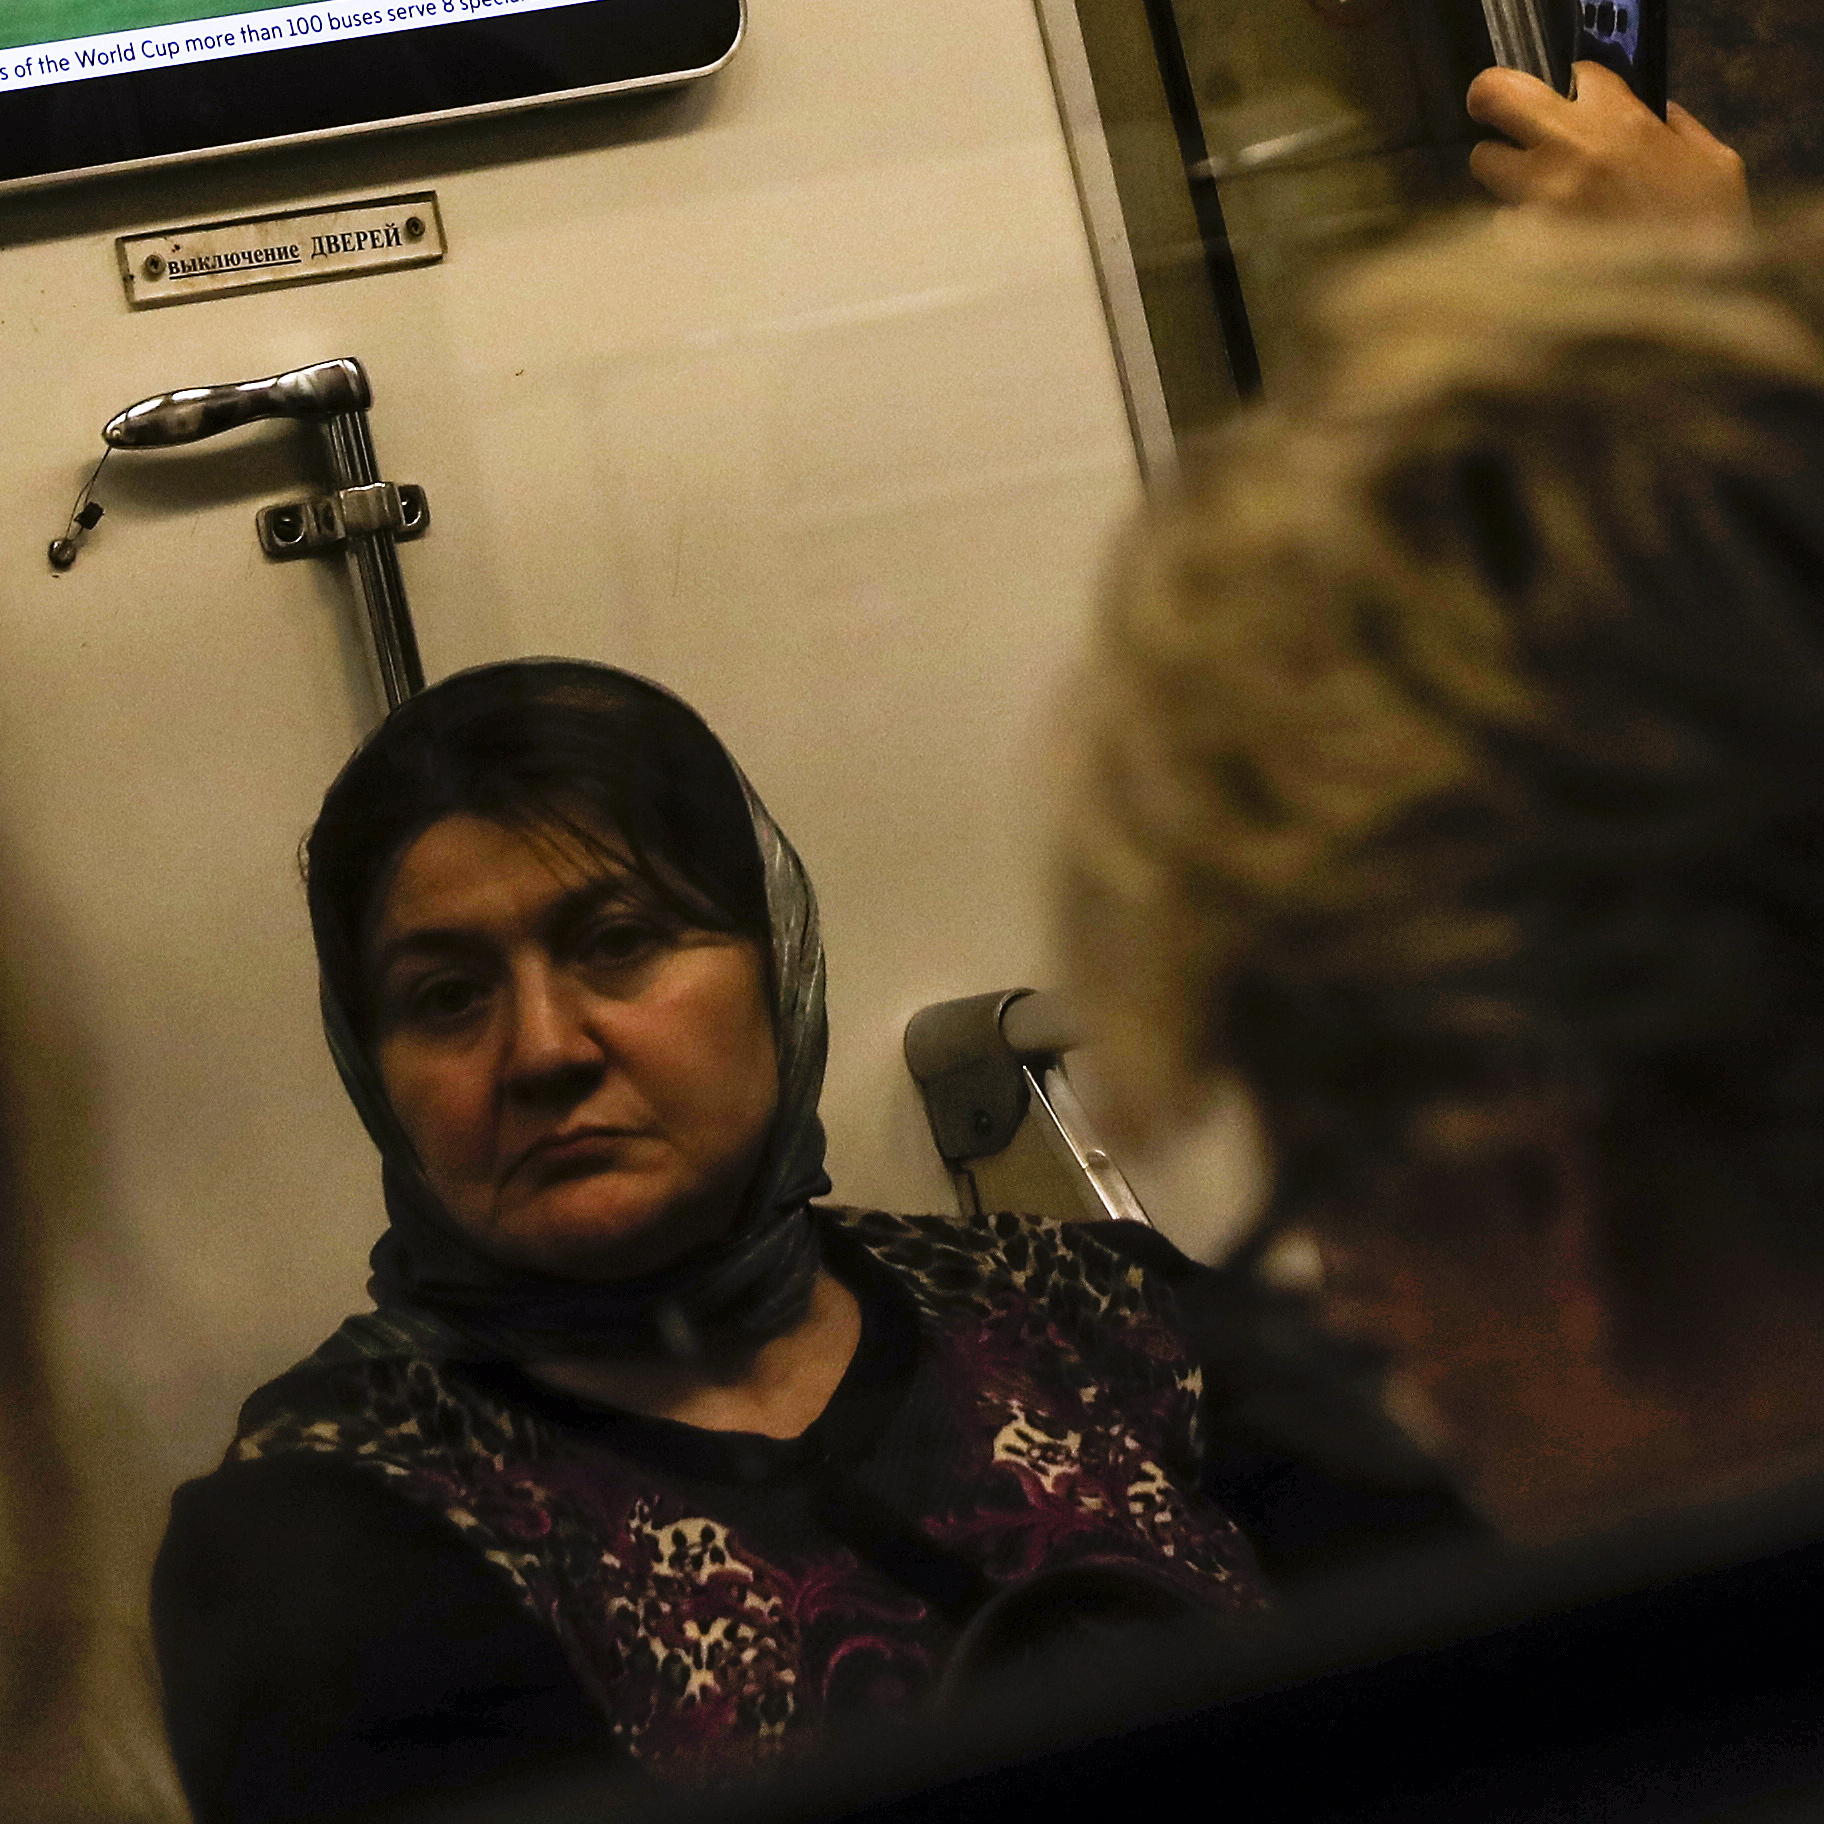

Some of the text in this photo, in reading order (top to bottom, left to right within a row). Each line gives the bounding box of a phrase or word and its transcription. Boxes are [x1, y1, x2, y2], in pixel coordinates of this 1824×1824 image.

[14, 57, 34, 78] of
[37, 54, 71, 75] the
[75, 43, 136, 70] World
[140, 38, 181, 64] Cup
[184, 32, 236, 53] more
[239, 21, 284, 45] than
[286, 14, 324, 38] 100
[327, 7, 384, 32] buses
[386, 0, 438, 22] serve
[166, 222, 403, 276] выключение ДВЕРЕЙ
